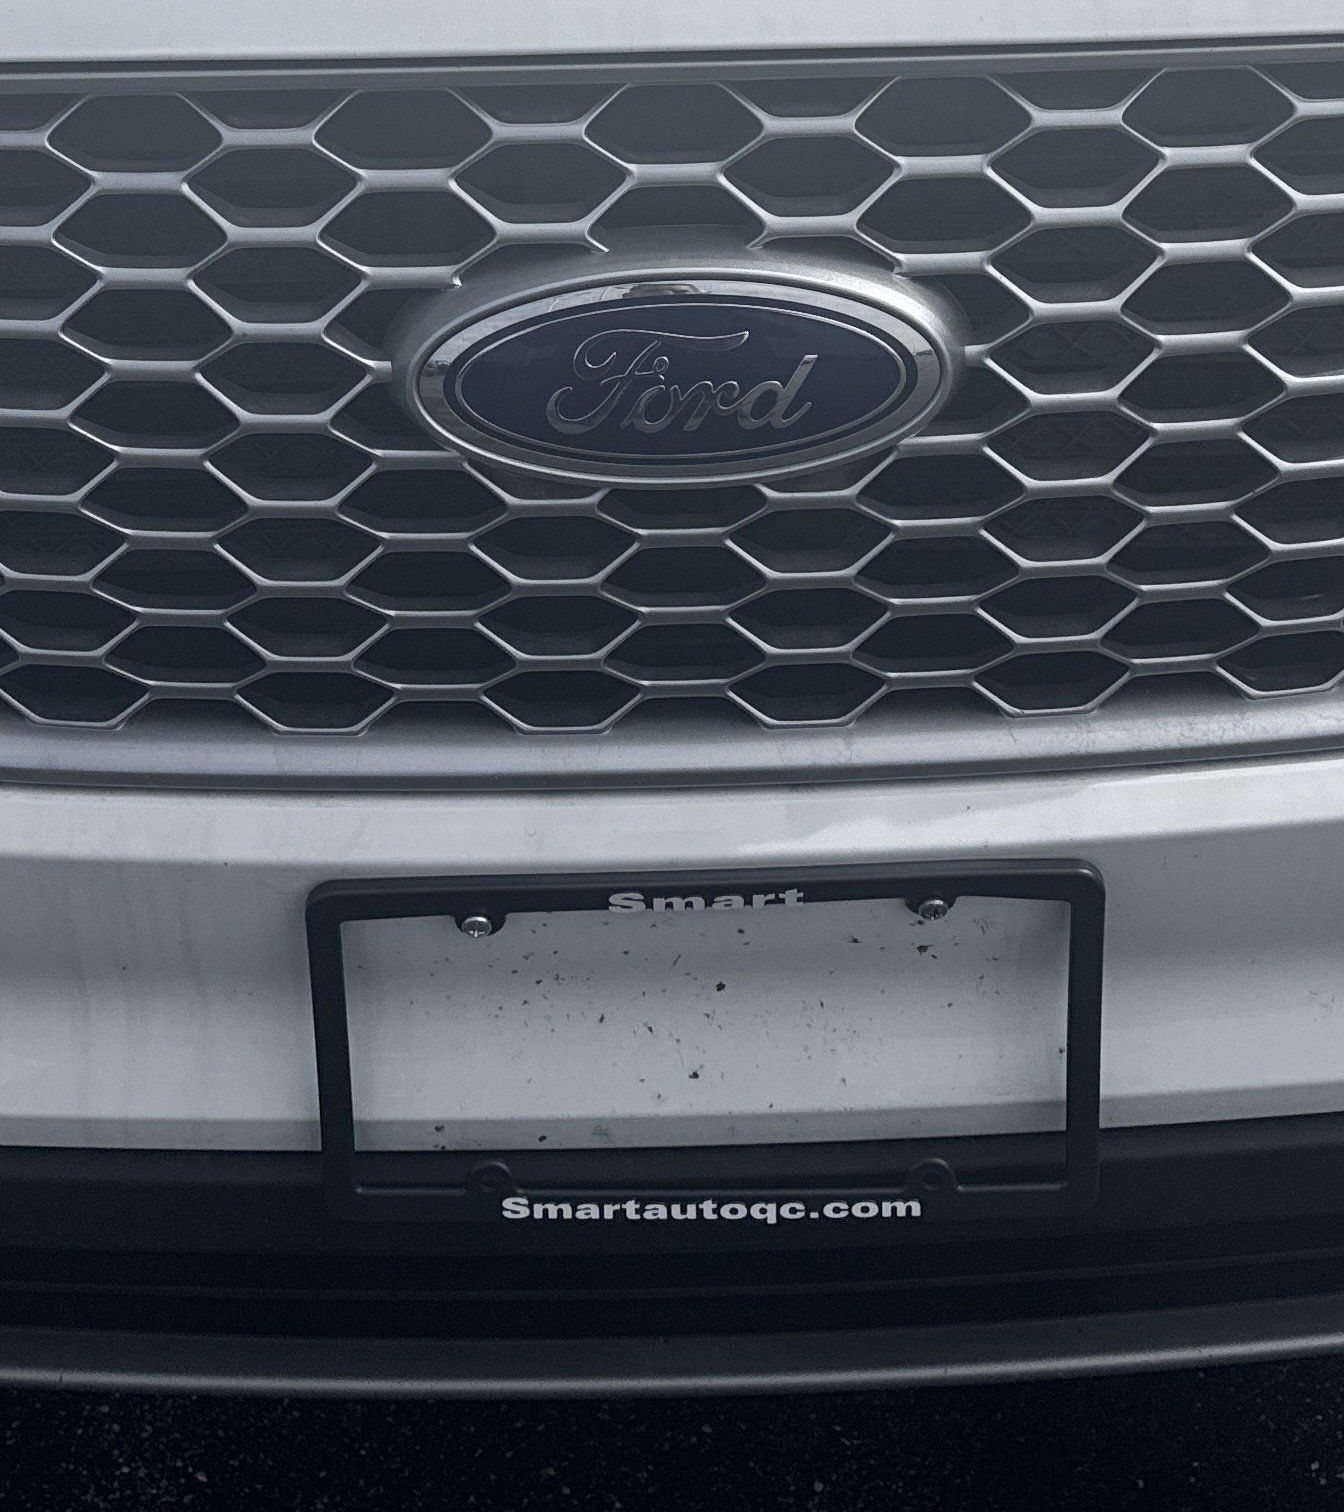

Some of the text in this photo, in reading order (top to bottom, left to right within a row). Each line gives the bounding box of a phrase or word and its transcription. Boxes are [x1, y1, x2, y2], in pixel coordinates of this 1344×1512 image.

[546, 328, 818, 435] Ford
[608, 888, 805, 913] Smart
[501, 1195, 923, 1224] Smartautoqc.com
